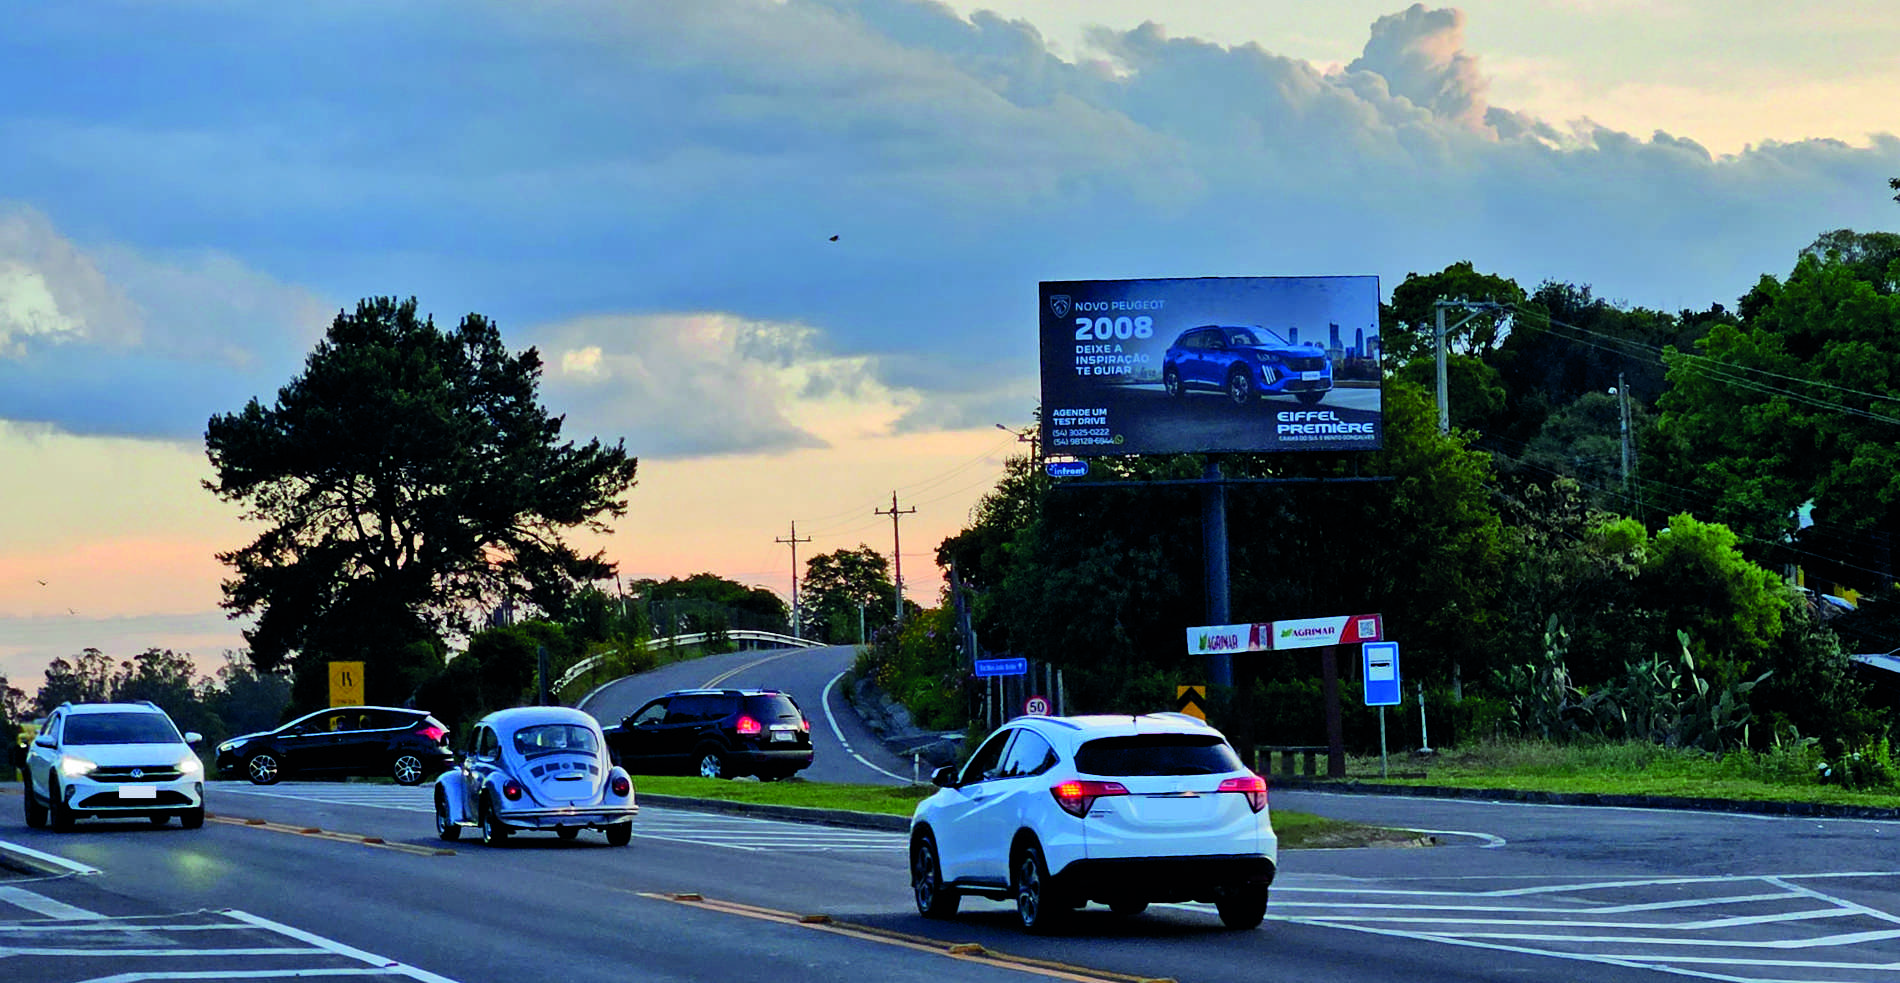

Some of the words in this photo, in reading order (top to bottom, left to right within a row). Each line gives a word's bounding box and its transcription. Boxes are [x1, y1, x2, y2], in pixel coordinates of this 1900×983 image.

[1075, 302, 1108, 312] NOVO
[1111, 300, 1166, 310] PEUGEOT
[1075, 316, 1153, 340] 2008
[1076, 345, 1111, 354] DEIXE
[1114, 344, 1122, 353] A
[1076, 353, 1149, 365] INSPIRAÇÃO
[1076, 366, 1091, 376] TE
[1094, 365, 1132, 375] GUIAR
[1092, 408, 1107, 416] UM
[1277, 411, 1339, 422] EIFFEL
[1053, 417, 1076, 425] TEST
[1078, 417, 1106, 425] DRIVE
[1277, 420, 1374, 434] PREMIÈRE
[1293, 626, 1335, 637] AGRIMAR
[1029, 701, 1045, 713] 50
